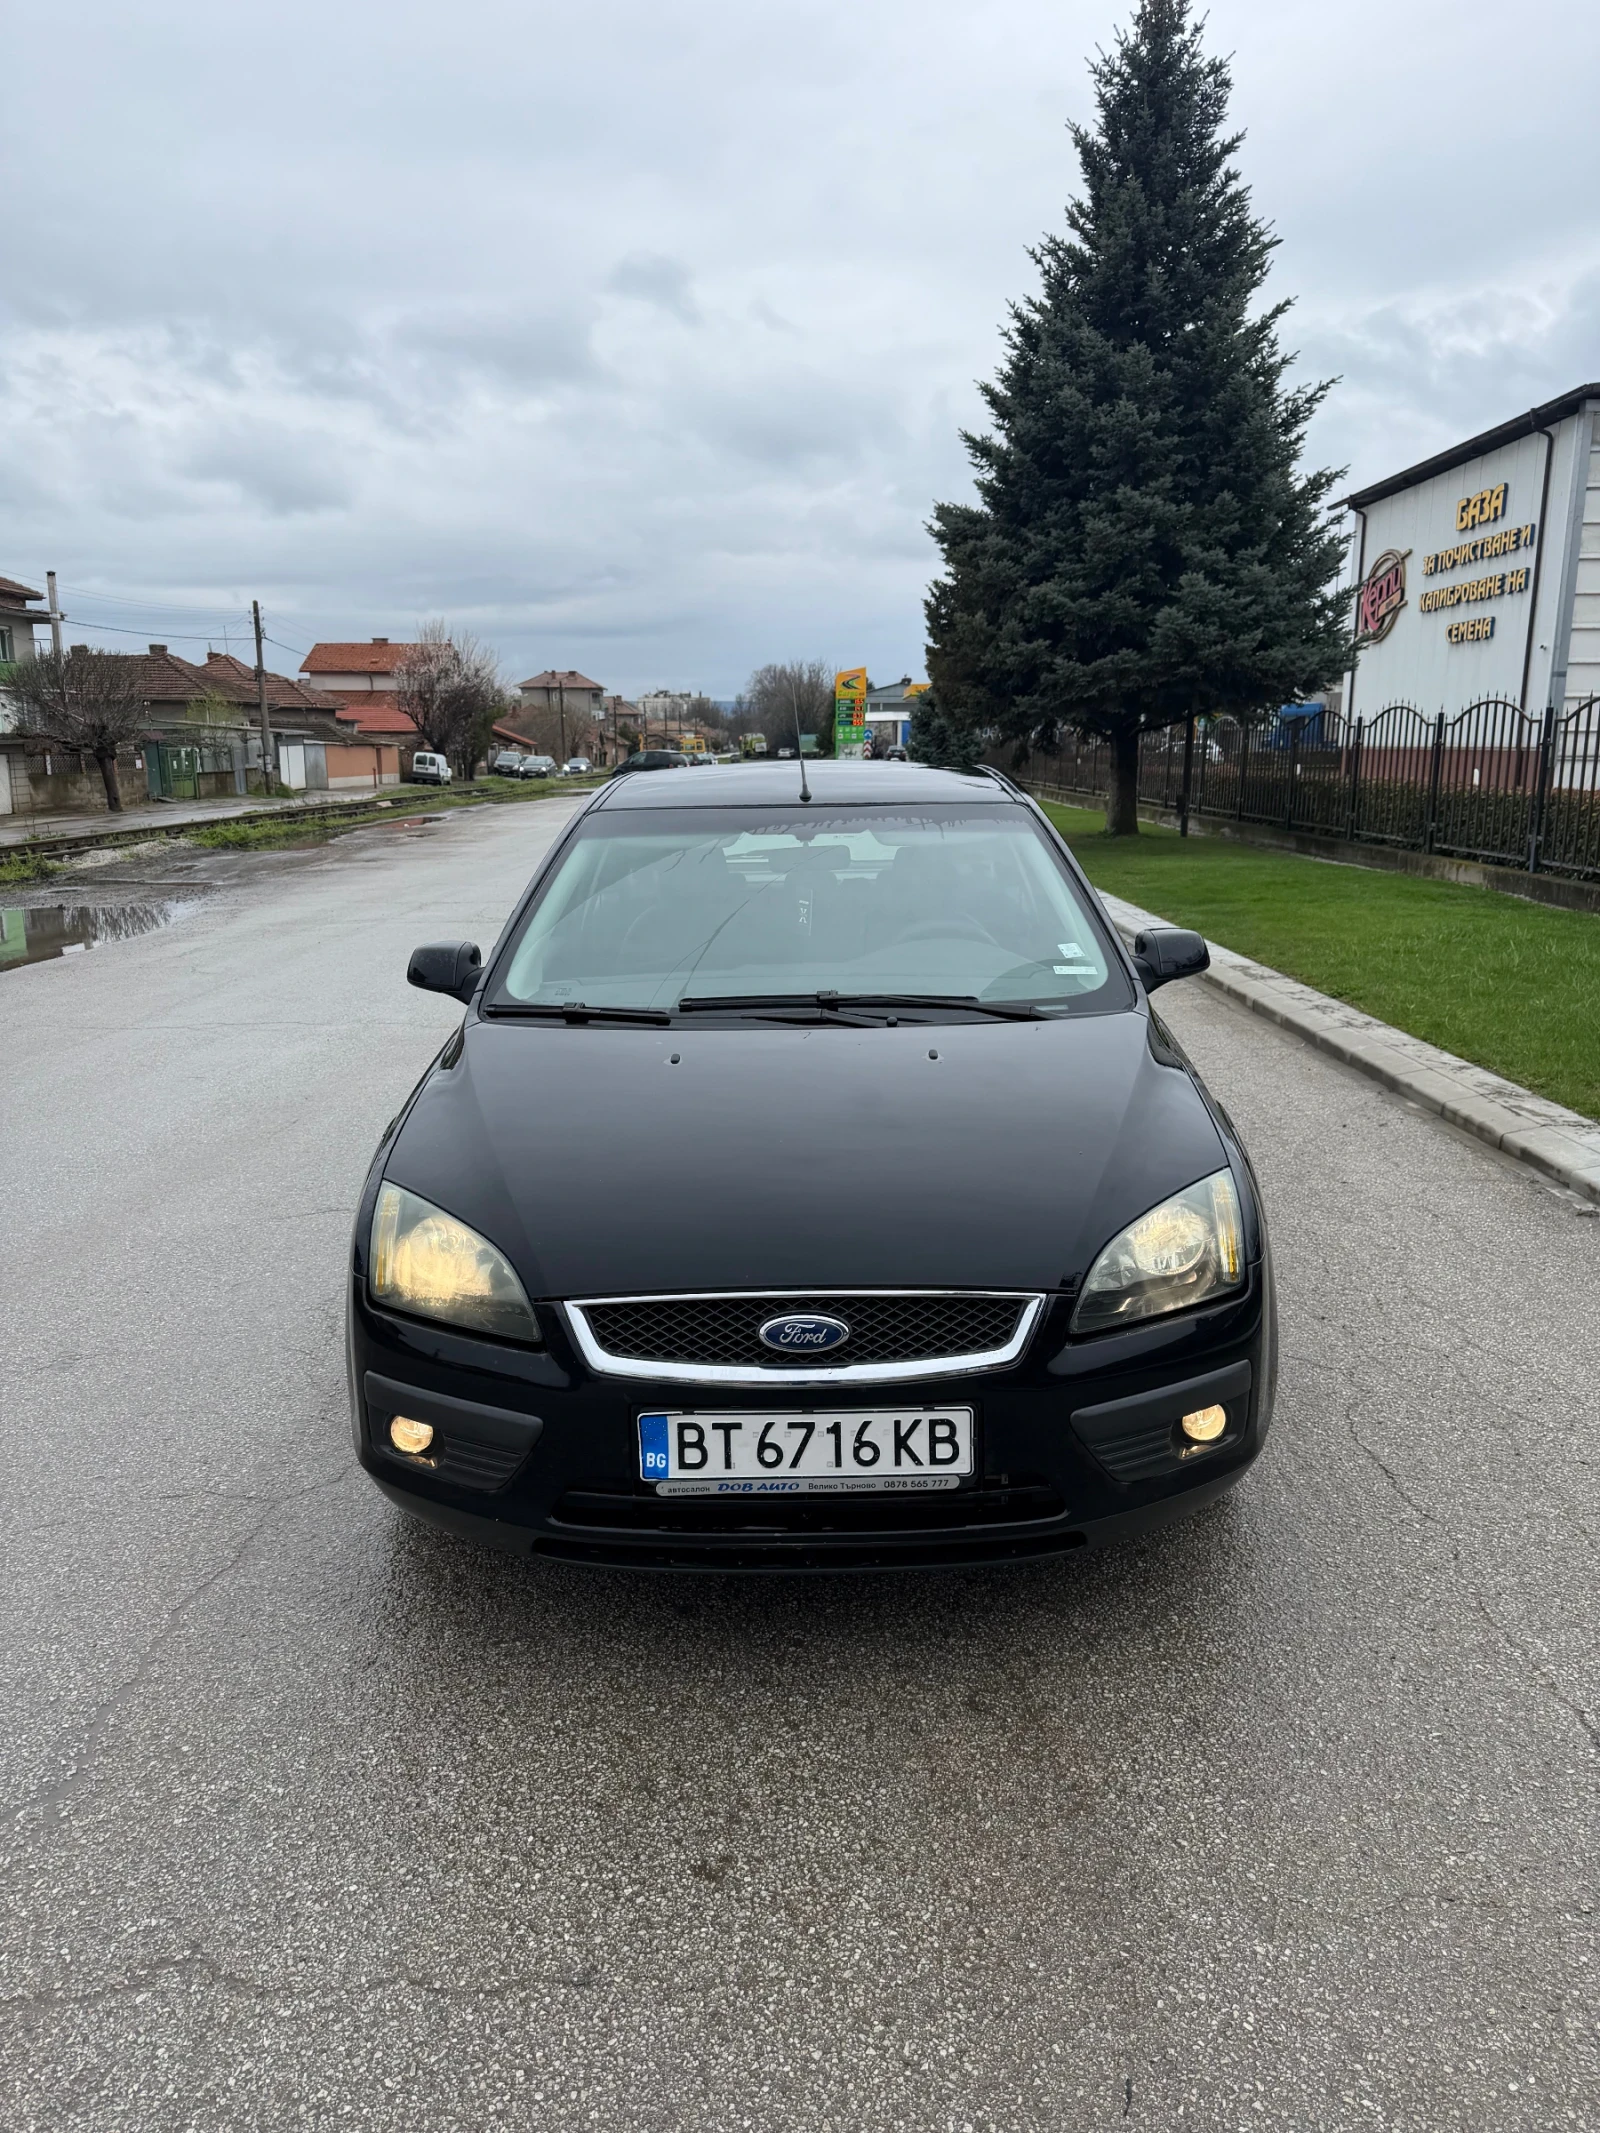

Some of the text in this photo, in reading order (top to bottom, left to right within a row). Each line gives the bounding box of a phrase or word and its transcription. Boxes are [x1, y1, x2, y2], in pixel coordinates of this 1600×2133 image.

[1456, 483, 1508, 531] БАЗА
[1422, 524, 1535, 576] ЗА ПОЧИСТВАНЕ И
[1420, 567, 1530, 612] КАЛИБРОВАНЕ НА
[1446, 616, 1495, 643] СЕМЕНА
[780, 1323, 827, 1344] Ford
[678, 1418, 960, 1470] BT 6716 KB
[646, 1452, 667, 1469] BG
[667, 1485, 710, 1494] автосалон
[717, 1482, 800, 1492] DOB AUTO
[808, 1479, 949, 1491] Велико Търново 0878 565 777
